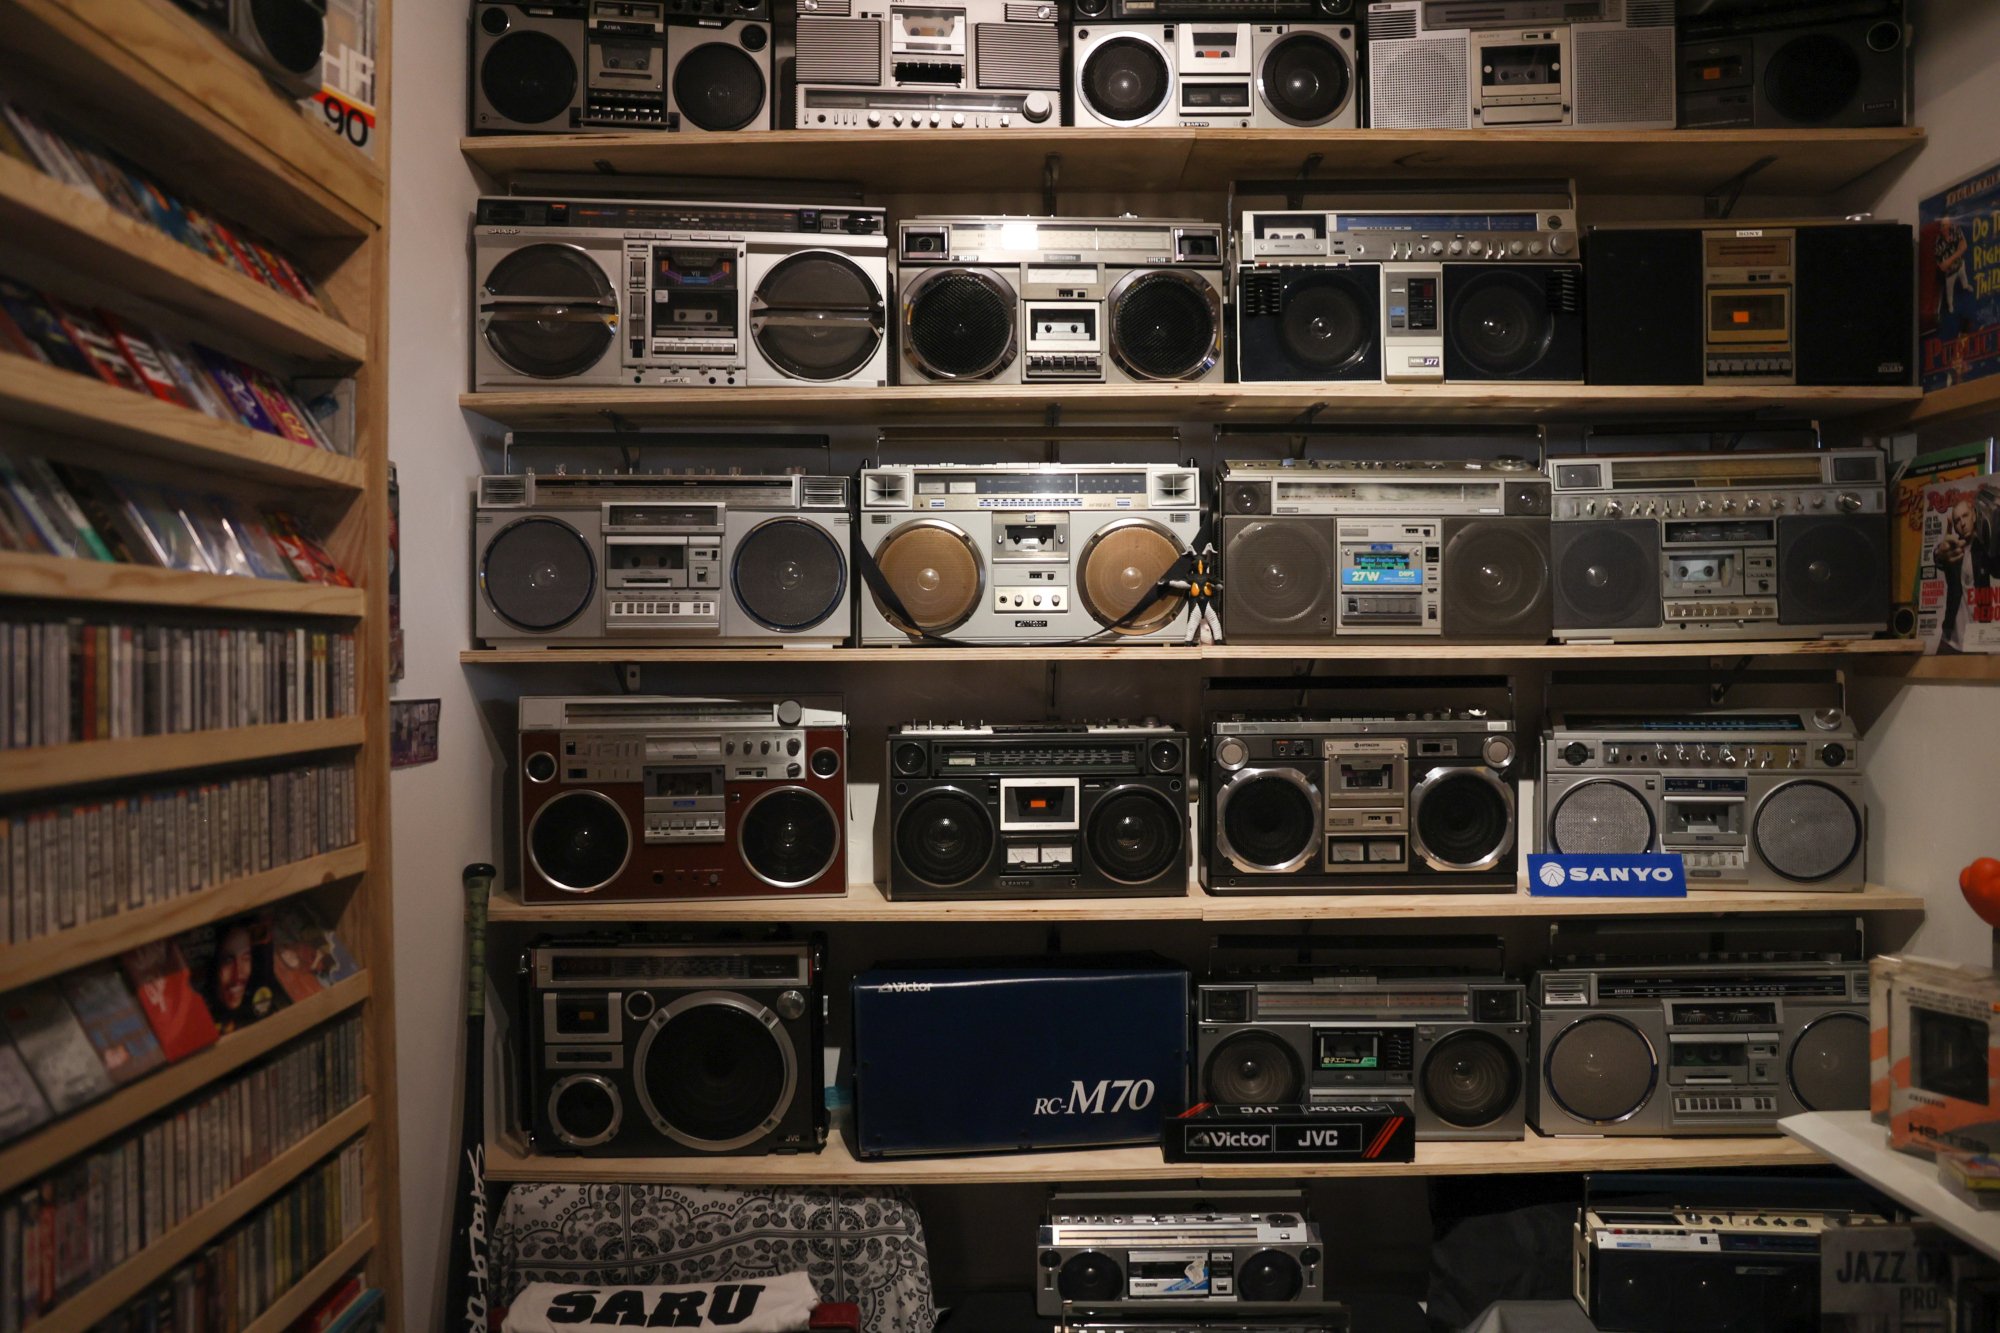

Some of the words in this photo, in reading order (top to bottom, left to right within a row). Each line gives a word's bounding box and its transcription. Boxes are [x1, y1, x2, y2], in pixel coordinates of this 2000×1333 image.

[324, 96, 369, 147] 90
[1973, 215, 1989, 243] Do
[1352, 571, 1380, 582] 27W
[1568, 867, 1674, 882] SANYO
[891, 982, 932, 993] Victor
[1033, 1078, 1155, 1115] RC-M70
[1240, 1105, 1279, 1114] JVC
[785, 1134, 800, 1142] JVC
[1209, 1131, 1271, 1147] Victor
[1297, 1130, 1338, 1147] JVC
[1836, 1250, 1907, 1284] JAZZ
[546, 1284, 766, 1328] SARU
